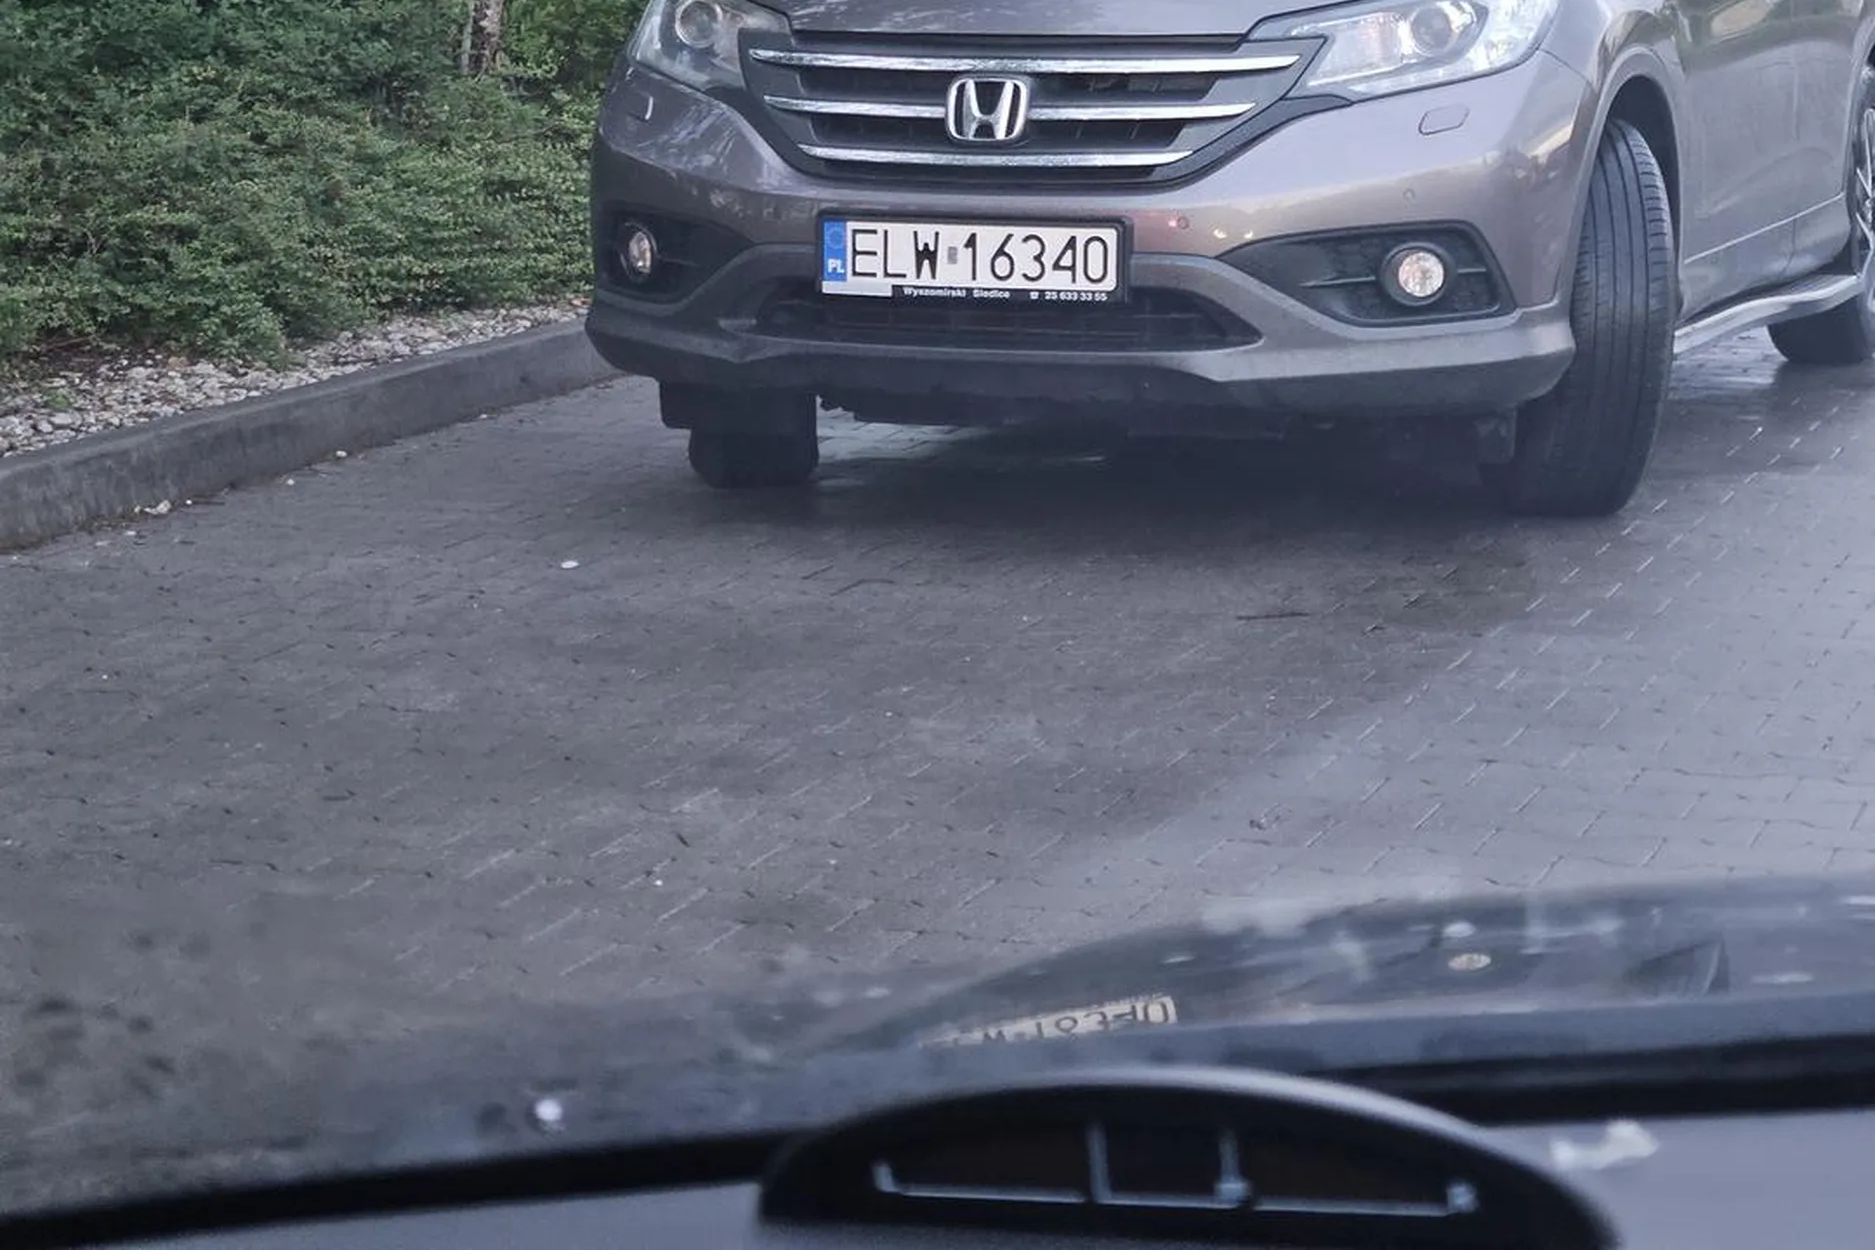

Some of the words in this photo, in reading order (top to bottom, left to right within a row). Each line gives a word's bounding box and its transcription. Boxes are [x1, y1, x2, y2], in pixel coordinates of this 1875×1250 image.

[828, 258, 845, 273] PL
[851, 228, 940, 280] ELW
[963, 232, 1109, 284] 16340
